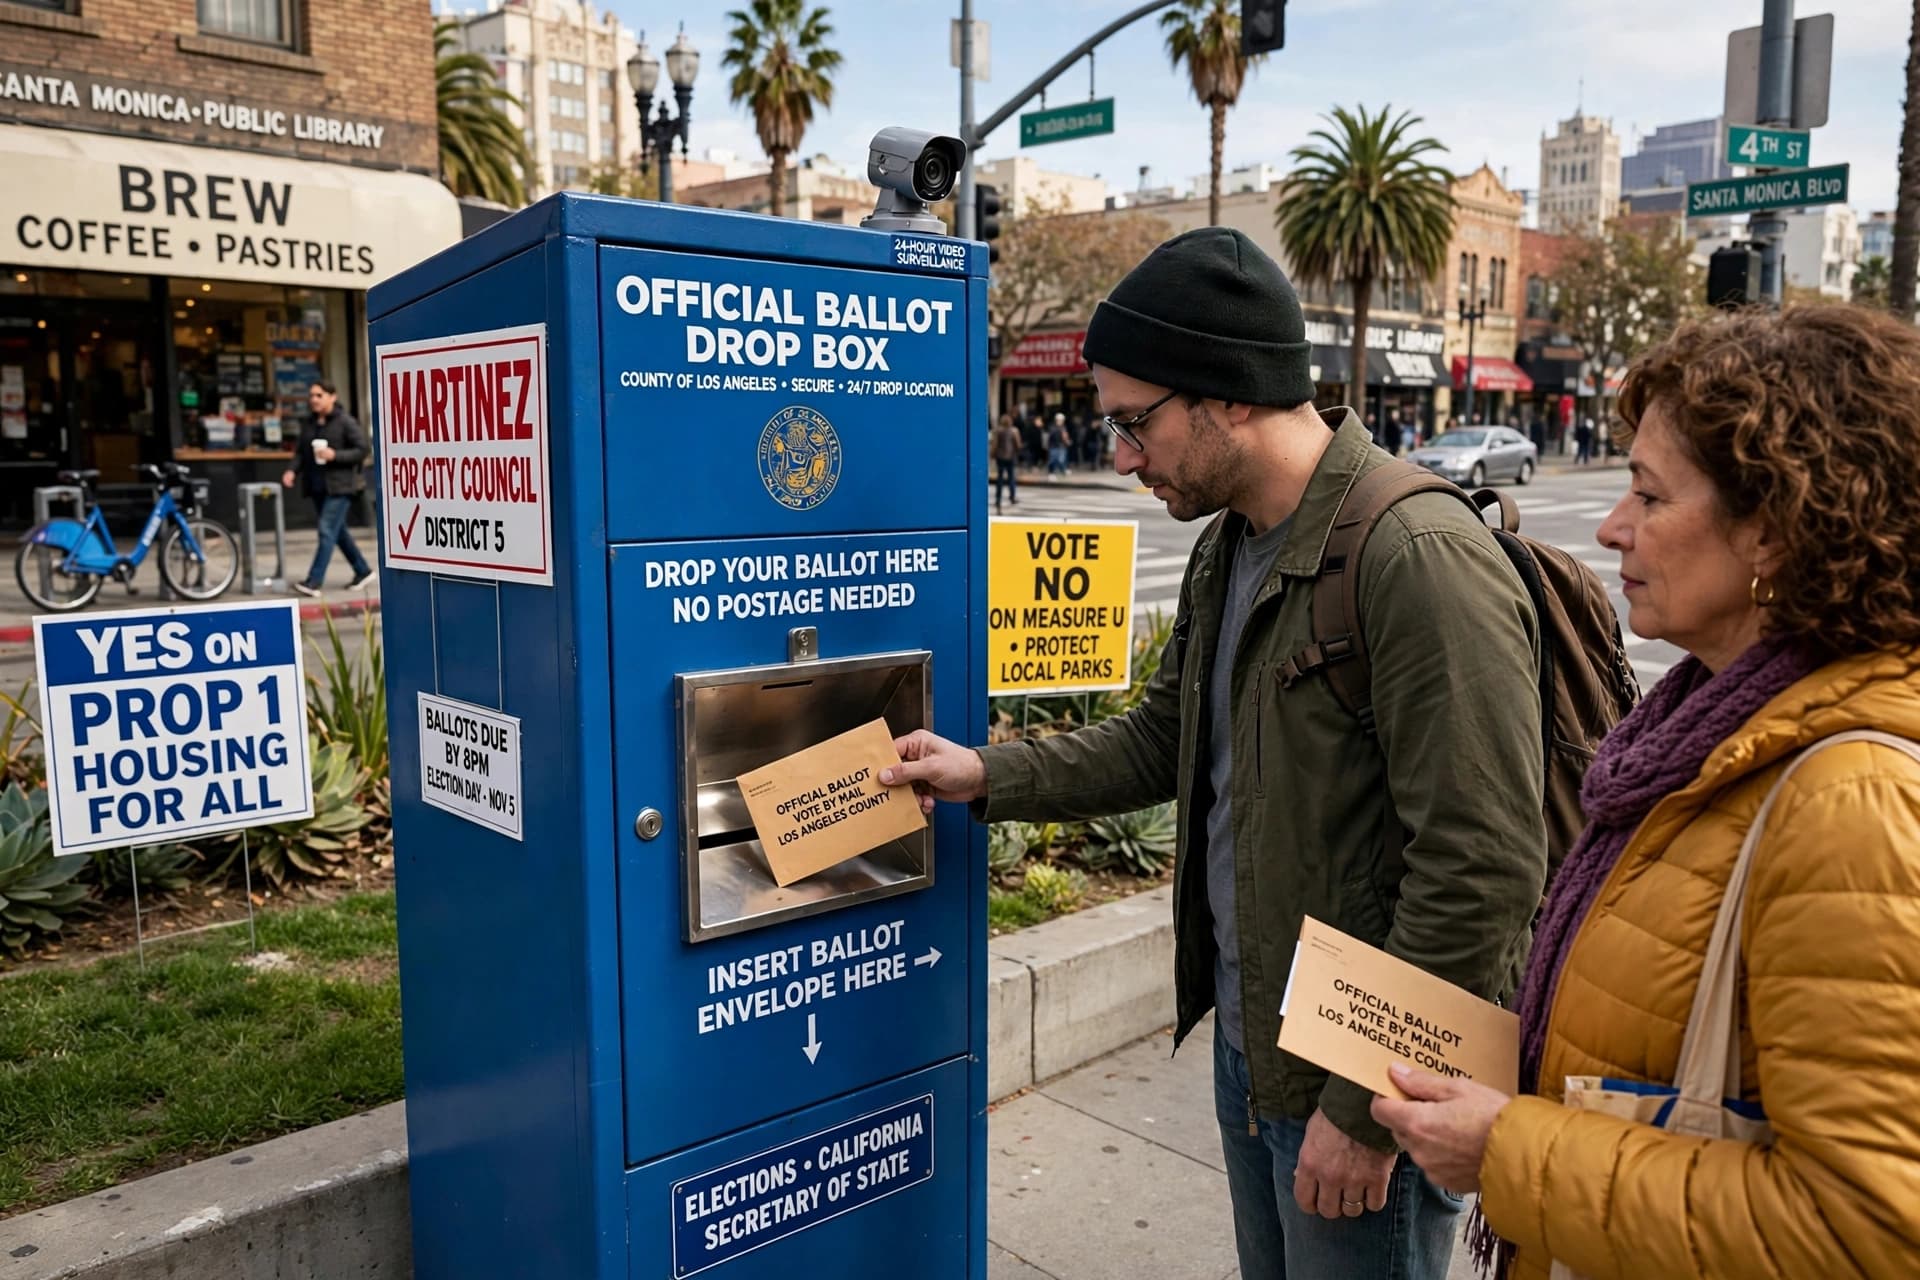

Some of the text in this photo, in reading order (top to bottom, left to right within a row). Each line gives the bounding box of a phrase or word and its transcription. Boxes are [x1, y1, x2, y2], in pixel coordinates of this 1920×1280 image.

[0, 72, 385, 148] ANTA MONICA PUBLIC LIBRARY
[1739, 132, 1802, 162] 4TH ST
[118, 164, 293, 226] BREW
[1693, 178, 1842, 210] SANTA MONICA BLVD
[17, 214, 375, 275] COFFEE PASTRIES
[894, 239, 966, 258] 24-HOUR VIDEO
[897, 252, 965, 271] SURVEILLANCE
[616, 275, 953, 334] OFFICIAL BALLOT
[686, 325, 890, 371] DROP BOX
[389, 359, 533, 443] MARTINEZ
[620, 371, 954, 397] COUNTY OF LOS ANGELES SECURE 24/7 DROP LOCATION
[391, 456, 537, 503] FOR CITY COUNCIL
[425, 516, 505, 552] DISTRICT 5
[1026, 532, 1099, 560] VOTE
[645, 548, 939, 588] DROP YOUR BALLOT HERE
[1034, 566, 1090, 601] NO
[673, 582, 916, 623] NO POSTAGE NEEDED
[989, 606, 1125, 629] ON MEASURE U
[75, 621, 257, 675] YES ON
[1025, 635, 1100, 656] PROTECT
[1001, 658, 1113, 682] LOCAL PARKS
[69, 675, 281, 746] PROP 1
[426, 707, 508, 753] BALLOTS DUE
[73, 732, 288, 792] HOUSING
[445, 741, 489, 776] BY 8PM
[88, 775, 282, 834] FOR ALL
[427, 766, 515, 816] ELECTION DAY NOV 5
[776, 787, 827, 815] OFFICIAL
[829, 768, 871, 794] BALLOT
[792, 787, 866, 823] VOTE BY MAIL
[777, 790, 891, 846] LOS ANGELES COUNTY
[708, 920, 904, 994] INSERT BALLOT
[698, 953, 906, 1035] ENVELOPE HERE
[1334, 979, 1463, 1048] OFFICIAL BALLOT
[1318, 1004, 1344, 1025] LOS
[1347, 1019, 1411, 1058] ANGELES
[1348, 1001, 1445, 1057] VOTE BY MAIL
[685, 1112, 923, 1222] ELECTIONS CALIFORNIA
[704, 1149, 910, 1251] SECRETARY OF STATE
